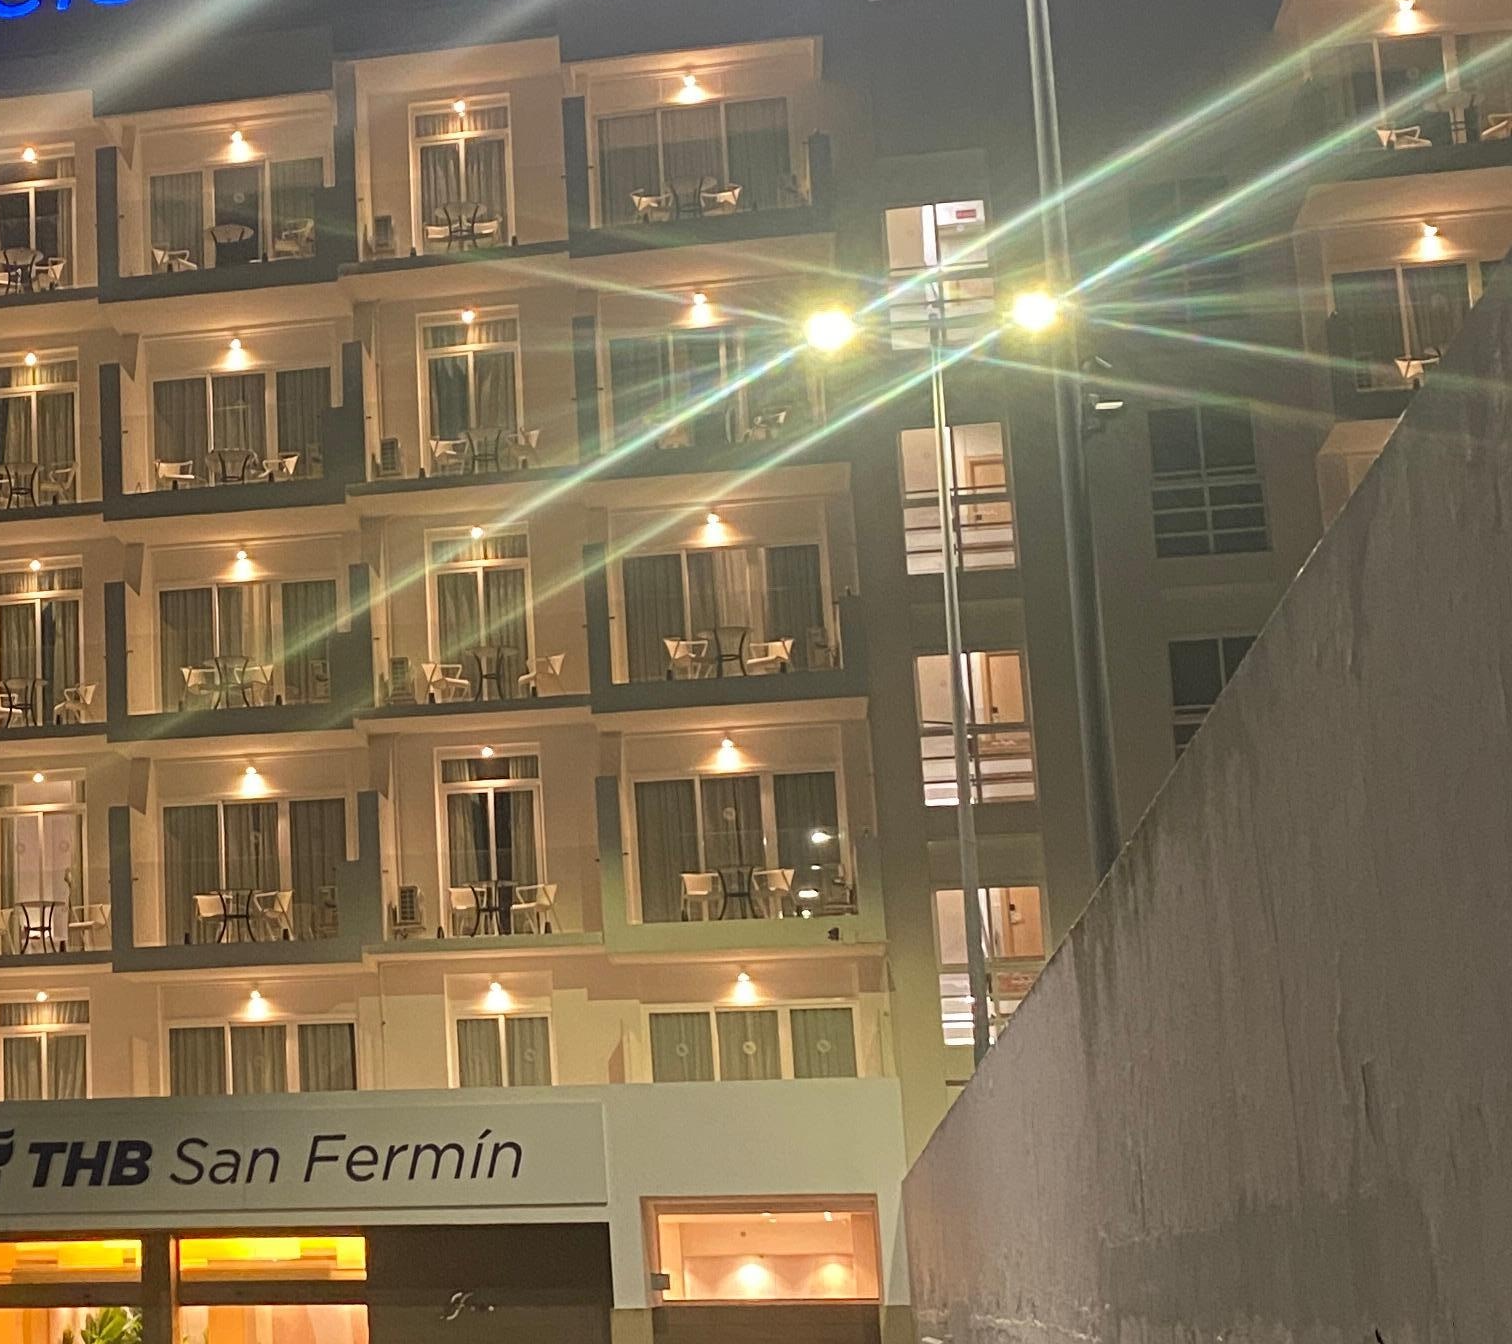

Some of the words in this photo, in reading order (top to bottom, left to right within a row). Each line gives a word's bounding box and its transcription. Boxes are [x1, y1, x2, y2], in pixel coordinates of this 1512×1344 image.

[28, 1139, 154, 1188] THB
[169, 1137, 281, 1186] San
[303, 1128, 524, 1183] Fermín
